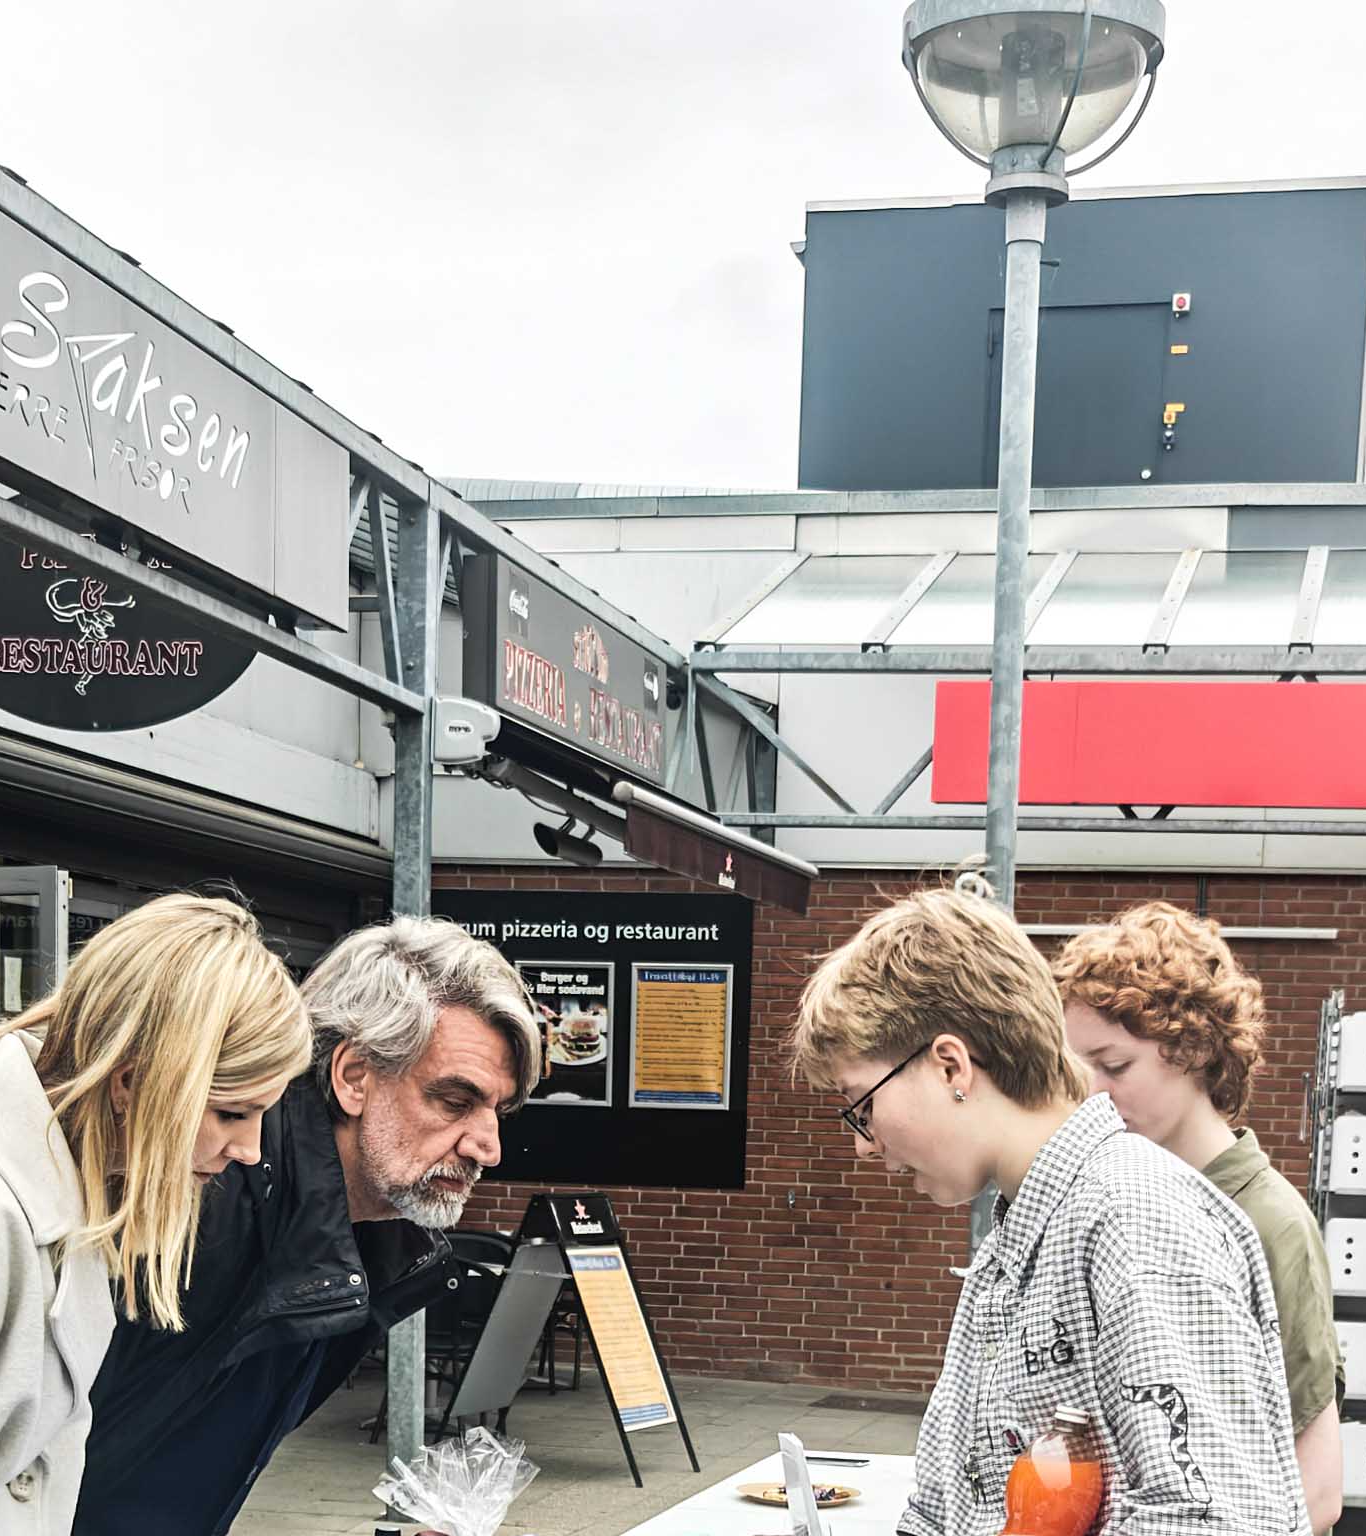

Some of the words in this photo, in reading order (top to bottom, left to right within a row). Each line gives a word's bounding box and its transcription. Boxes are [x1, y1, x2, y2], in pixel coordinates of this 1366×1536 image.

[503, 639, 567, 728] PIZZERIA
[461, 923, 495, 937] rum
[501, 919, 577, 941] pizzeria
[584, 924, 610, 943] og
[615, 922, 719, 941] restaurant
[540, 972, 574, 985] Burger
[575, 973, 589, 985] og
